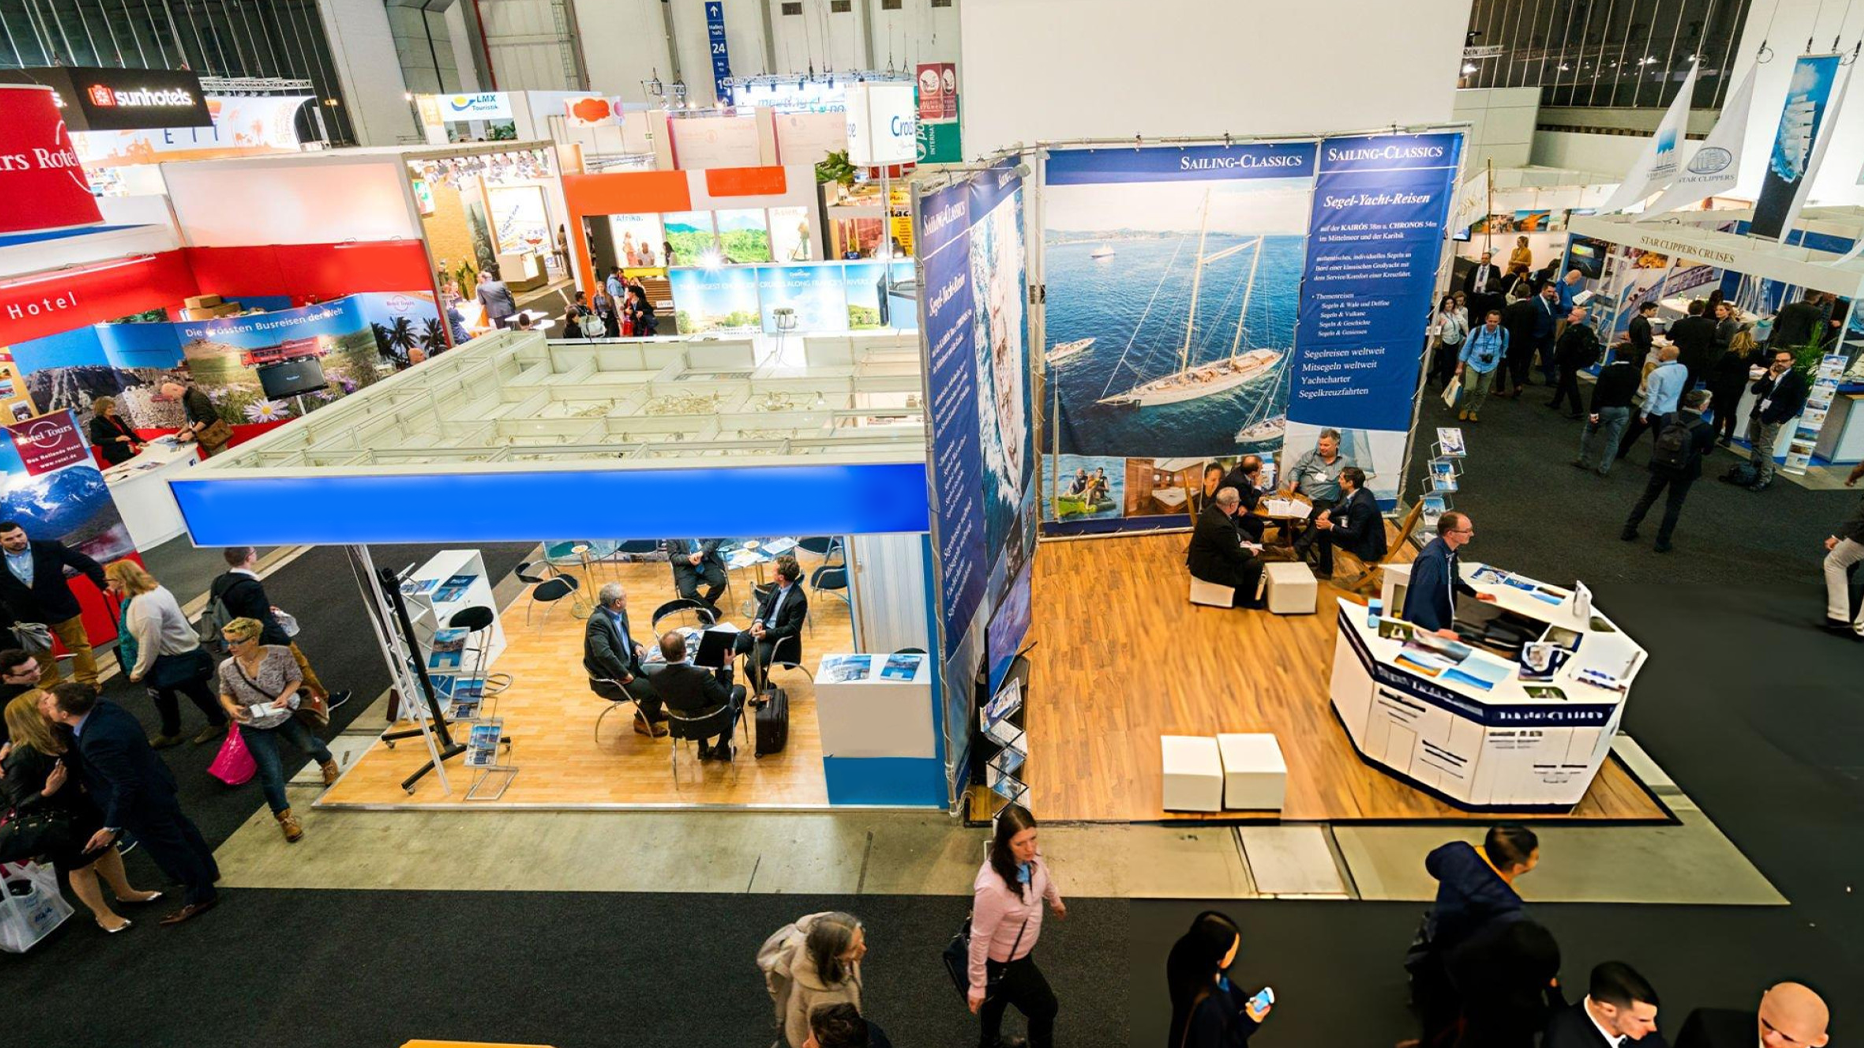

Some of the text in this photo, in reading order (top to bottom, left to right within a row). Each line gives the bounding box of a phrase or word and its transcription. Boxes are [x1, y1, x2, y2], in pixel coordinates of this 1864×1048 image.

[712, 43, 726, 54] 24
[476, 95, 497, 103] LMX
[32, 147, 80, 169] Rotel
[1698, 174, 1735, 182] CLIPPERS
[1323, 192, 1431, 210] Segel-Yacht-Reisen
[1389, 221, 1423, 229] CHRONOS
[1328, 234, 1359, 242] Mittelmeer
[1372, 232, 1382, 240] der
[1382, 231, 1404, 239] Karibik
[1640, 236, 1735, 263] STAR CLIPPERS CRUISES
[7, 291, 77, 320] Hotel
[1321, 302, 1339, 310] Segeln
[185, 327, 203, 338] Die
[255, 317, 306, 331] Busreisen
[308, 311, 325, 323] der
[1319, 321, 1336, 329] Segeln
[1318, 330, 1335, 338] Segeln
[1304, 346, 1385, 360] Segelreisen weltweit
[1302, 359, 1377, 373] Mitsegeln weltweit
[1301, 375, 1351, 385] Yachtcharter
[1298, 387, 1369, 400] Segelkreuzfahrten
[45, 424, 72, 438] Tours
